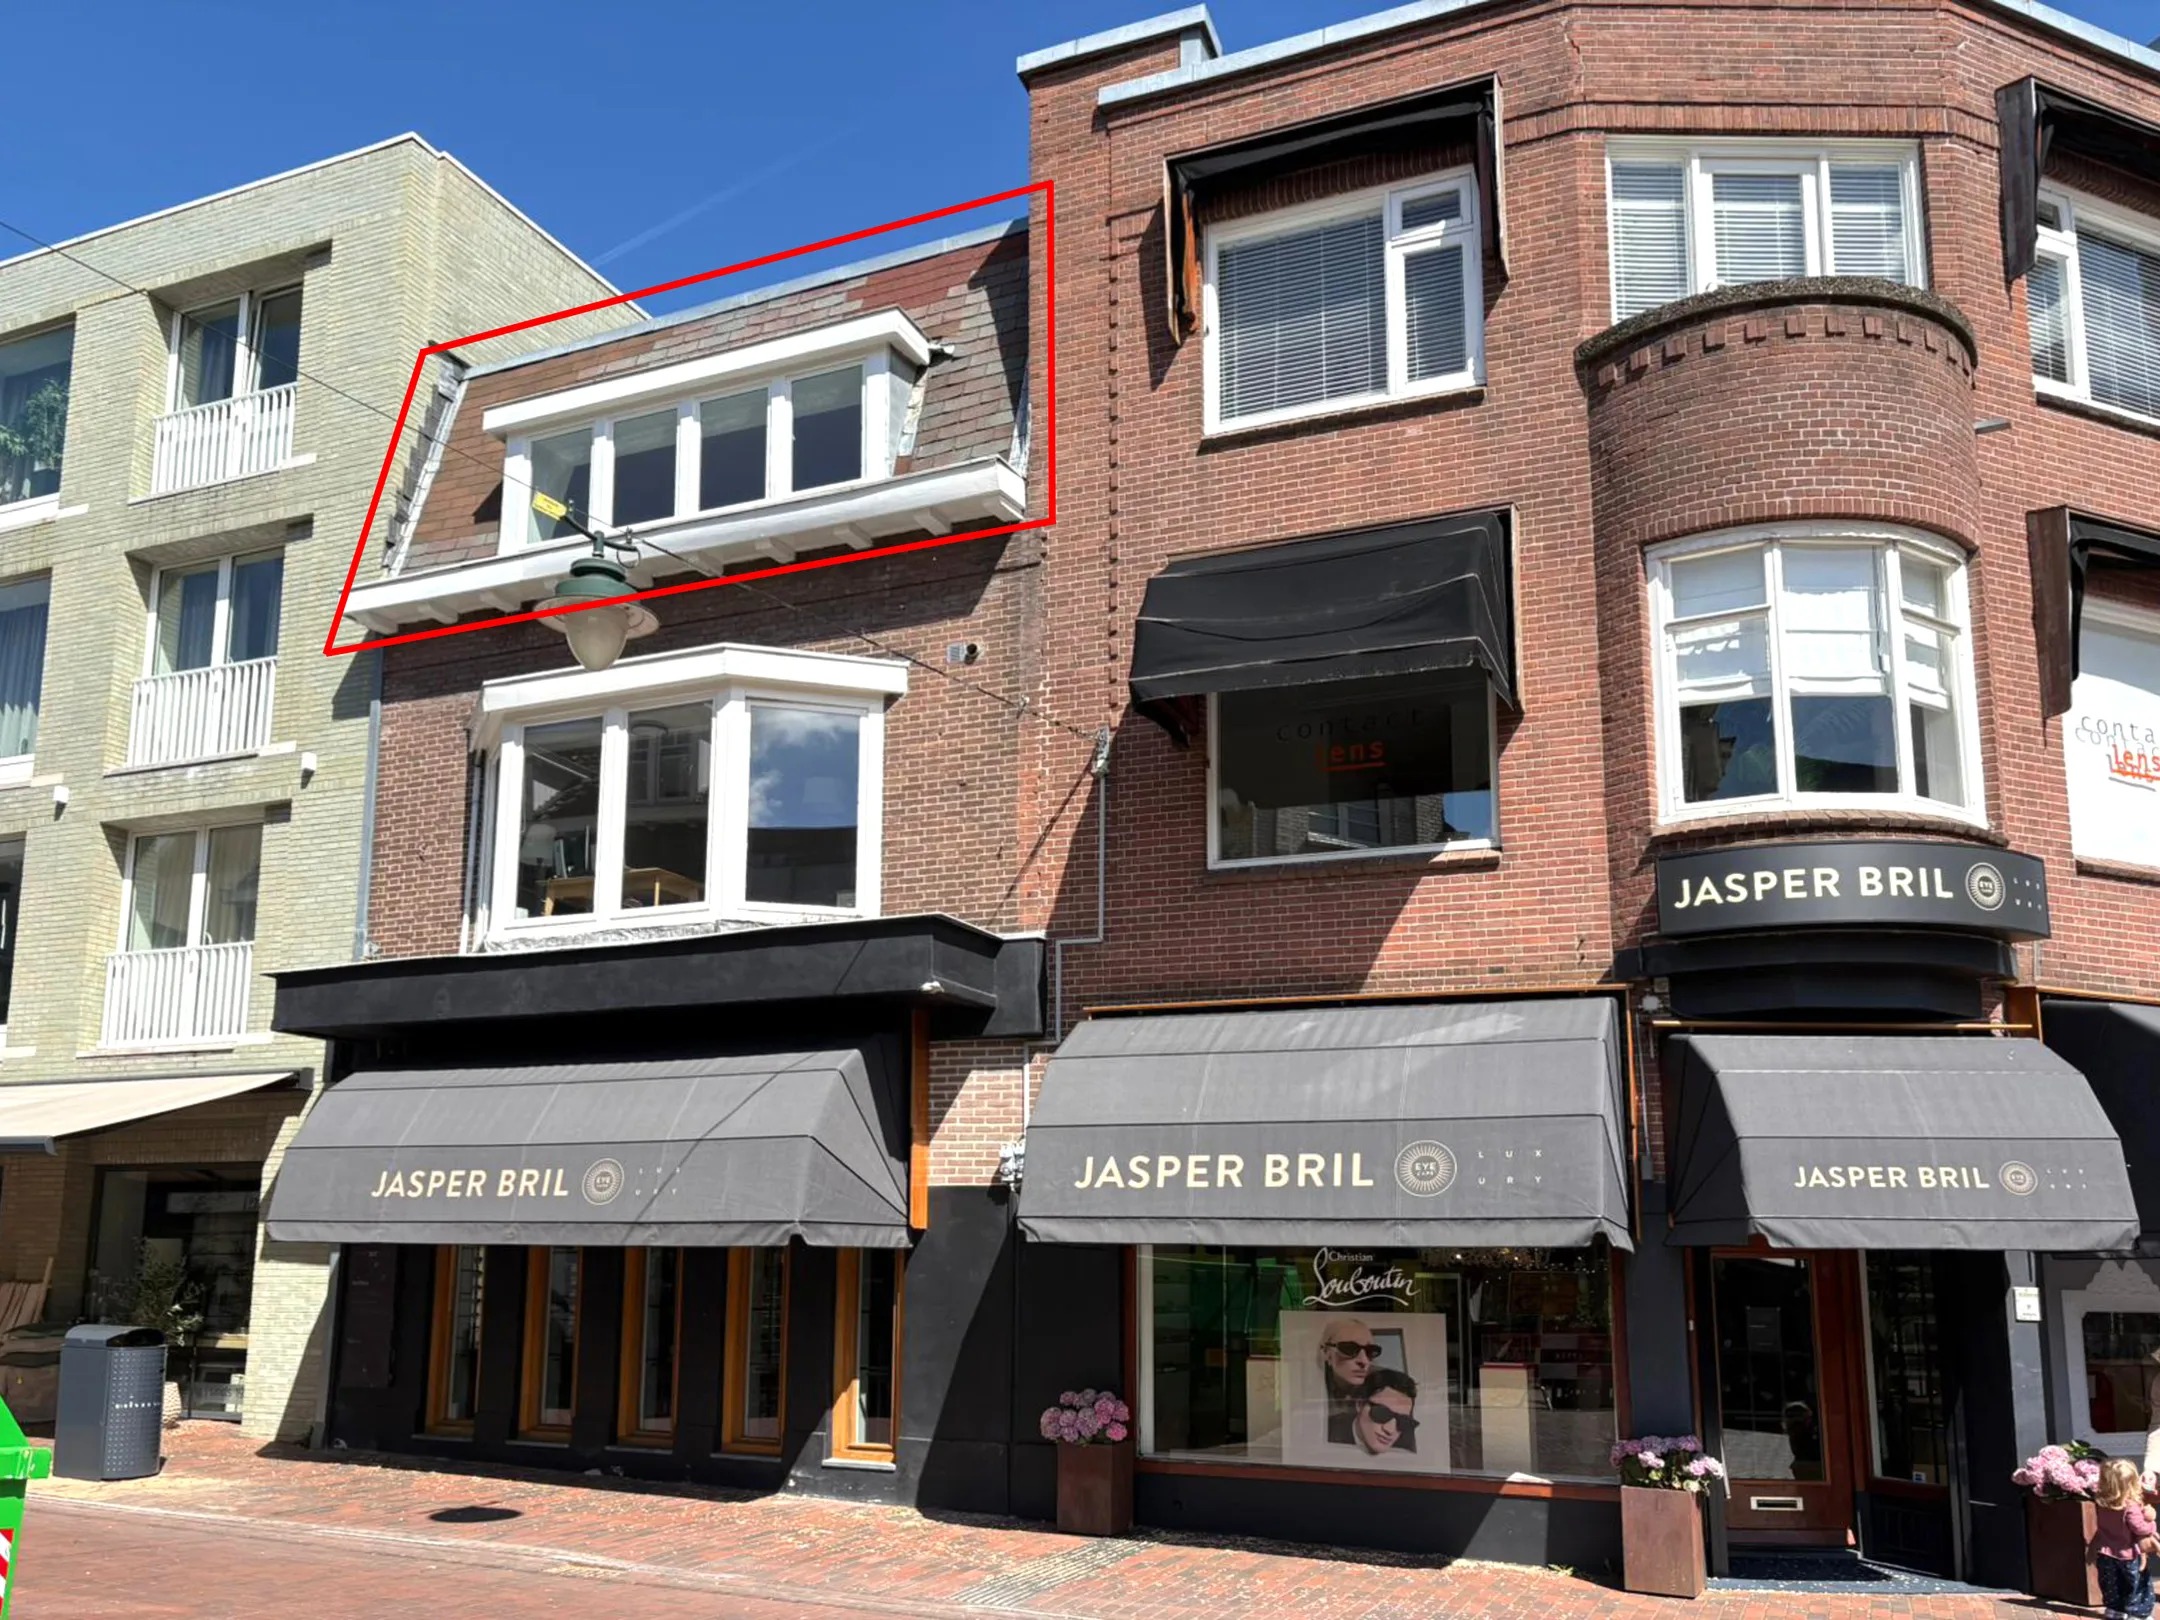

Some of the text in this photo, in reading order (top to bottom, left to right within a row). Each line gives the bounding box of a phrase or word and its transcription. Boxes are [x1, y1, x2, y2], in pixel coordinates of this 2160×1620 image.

[1276, 708, 1420, 741] contact
[2081, 715, 2156, 745] conta
[1673, 866, 1954, 909] JASPER BRIL
[371, 1168, 569, 1198] JASPER BRIL
[1074, 1152, 1374, 1189] JASPER BRIL
[1794, 1166, 1908, 1188] JASPER
[1918, 1166, 1990, 1189] BRIL
[1328, 1251, 1374, 1262] Christian
[1302, 1247, 1421, 1306] Louboutin
